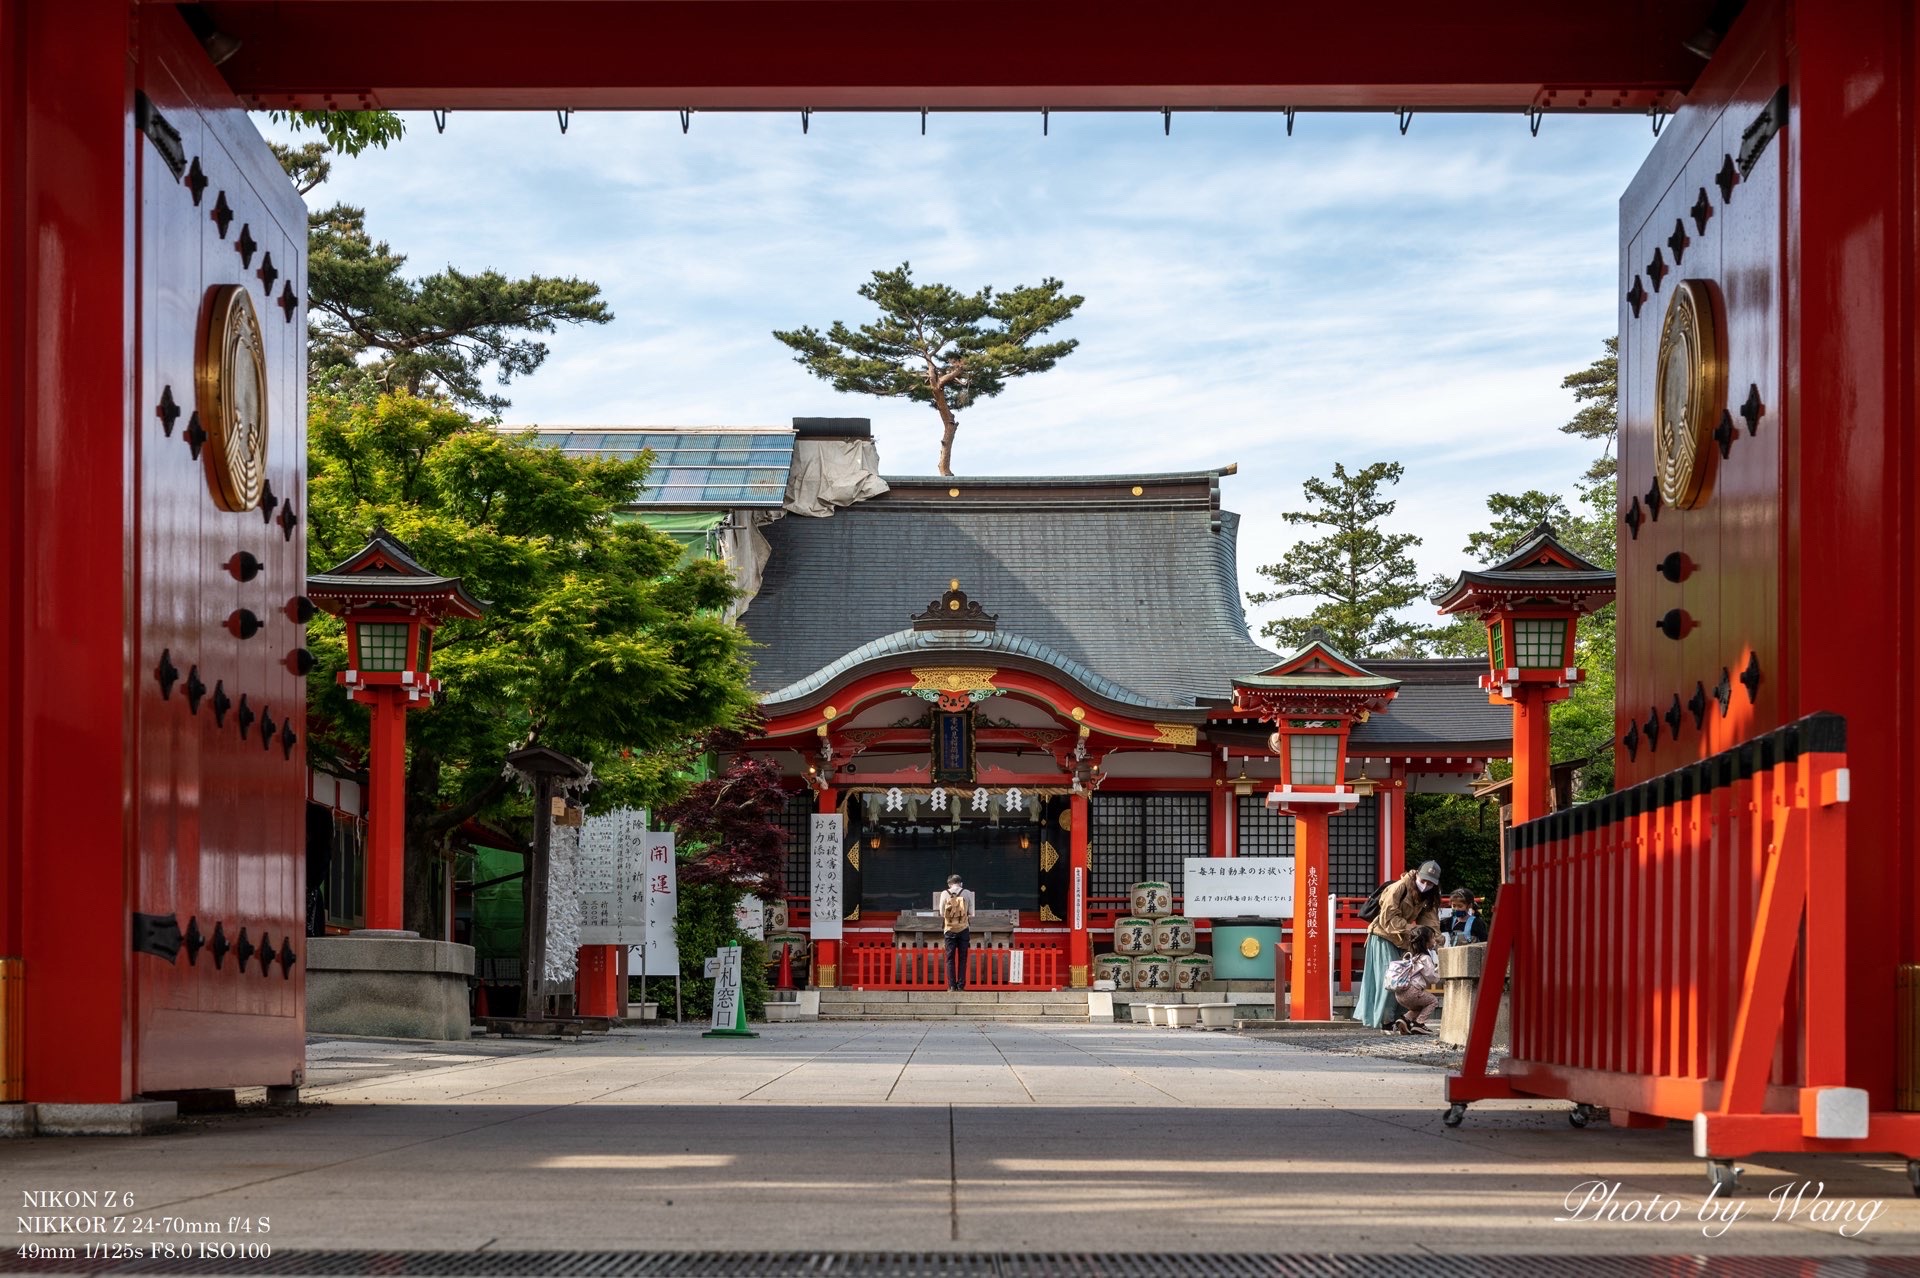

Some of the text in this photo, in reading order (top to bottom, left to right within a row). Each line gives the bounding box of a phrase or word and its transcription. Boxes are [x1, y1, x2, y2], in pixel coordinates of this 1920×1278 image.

[650, 846, 671, 895] 開運
[814, 819, 826, 919] お力添えください
[826, 819, 839, 921] 台風被害の大修繕
[1307, 866, 1318, 938] 東伏見稲荷睦会
[716, 946, 738, 1027] 古札窓口
